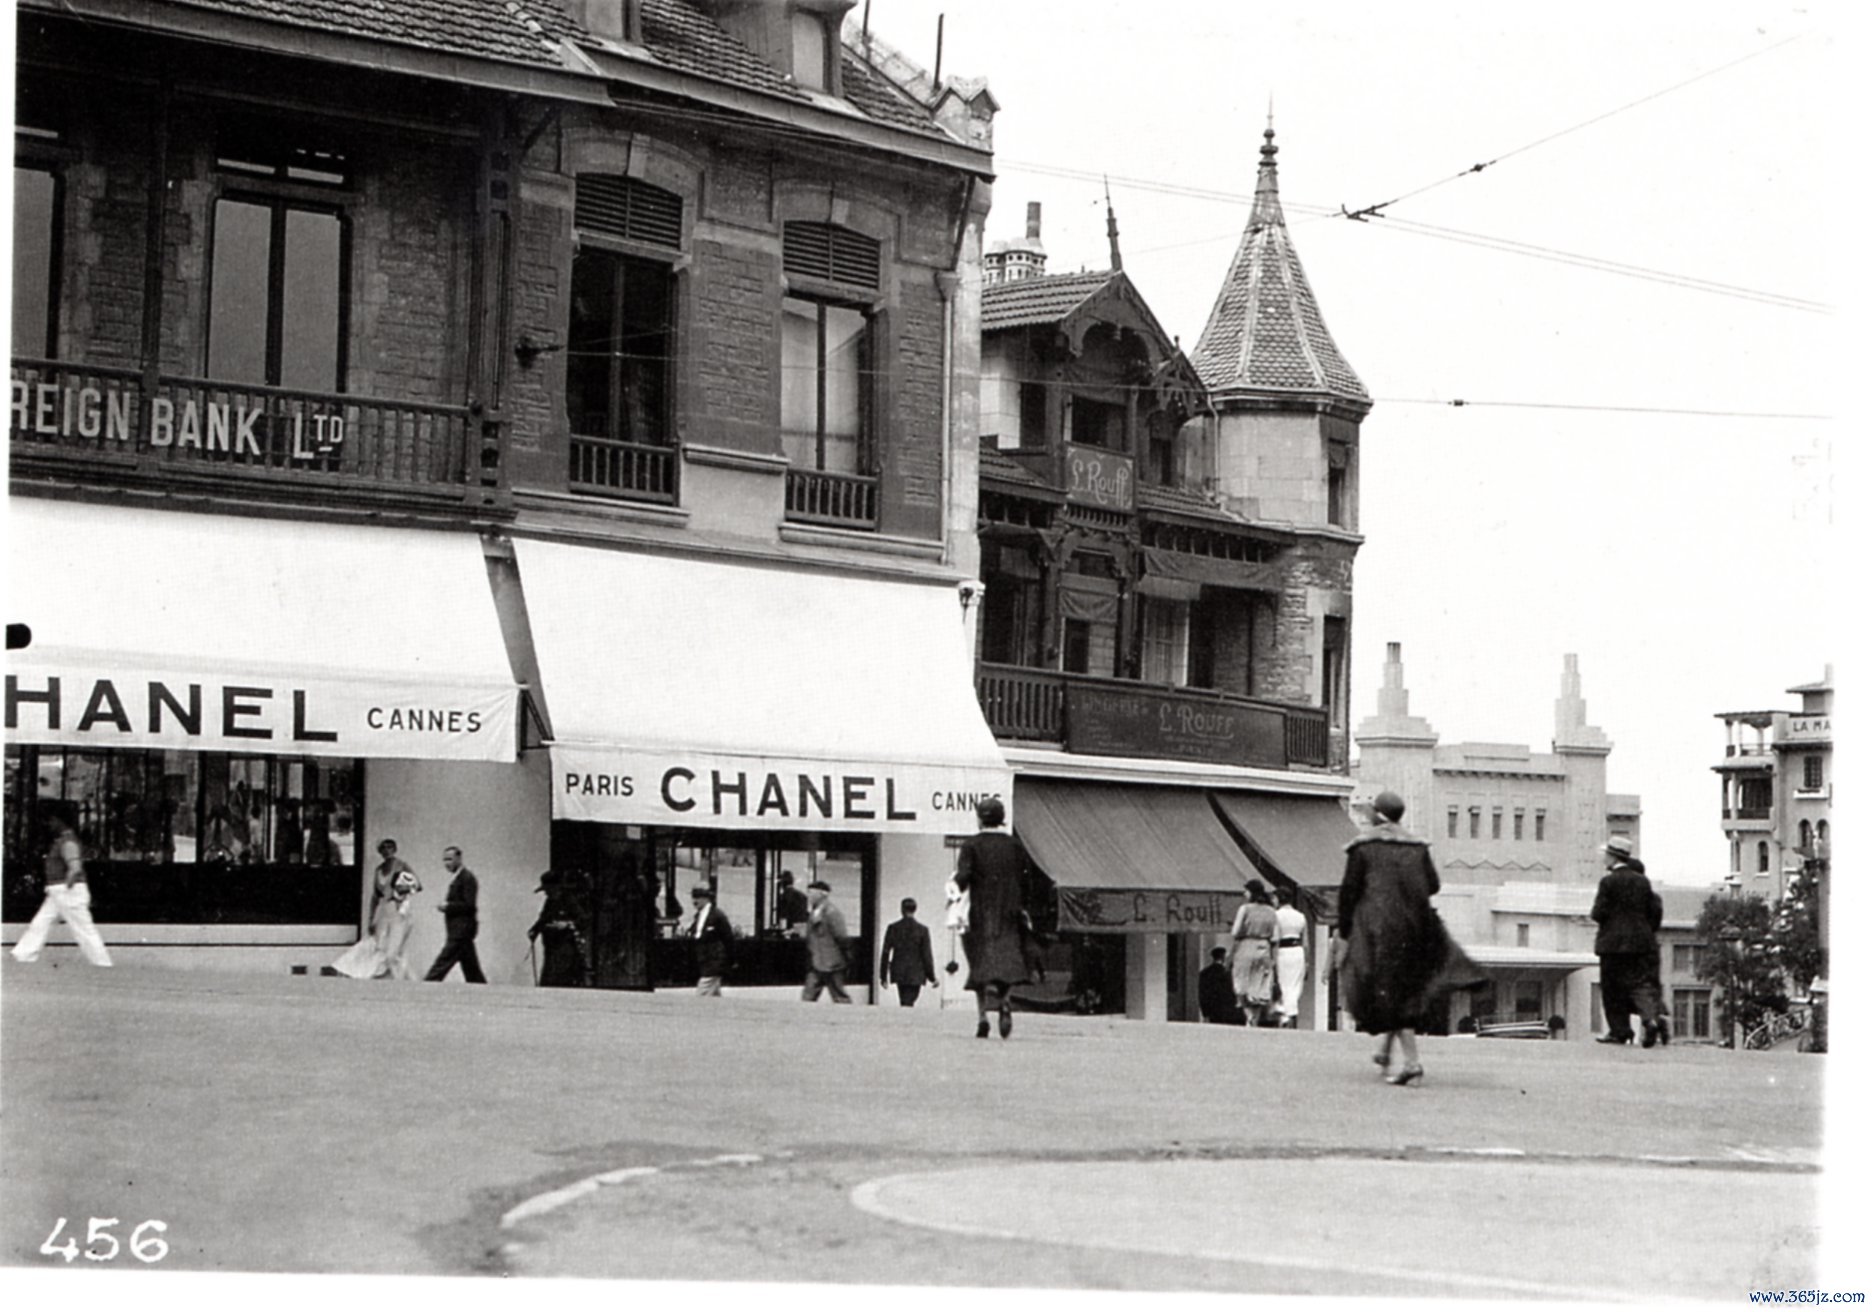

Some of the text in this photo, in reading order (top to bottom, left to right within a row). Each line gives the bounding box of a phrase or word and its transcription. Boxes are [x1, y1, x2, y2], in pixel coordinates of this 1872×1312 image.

[11, 381, 131, 440] REIGN
[151, 398, 261, 456] BANK
[1087, 461, 1129, 506] Rouff
[5, 674, 482, 742] HANEL CANNES
[1793, 720, 1831, 732] LA MA
[565, 766, 1002, 821] PARIS CHANEL CANN
